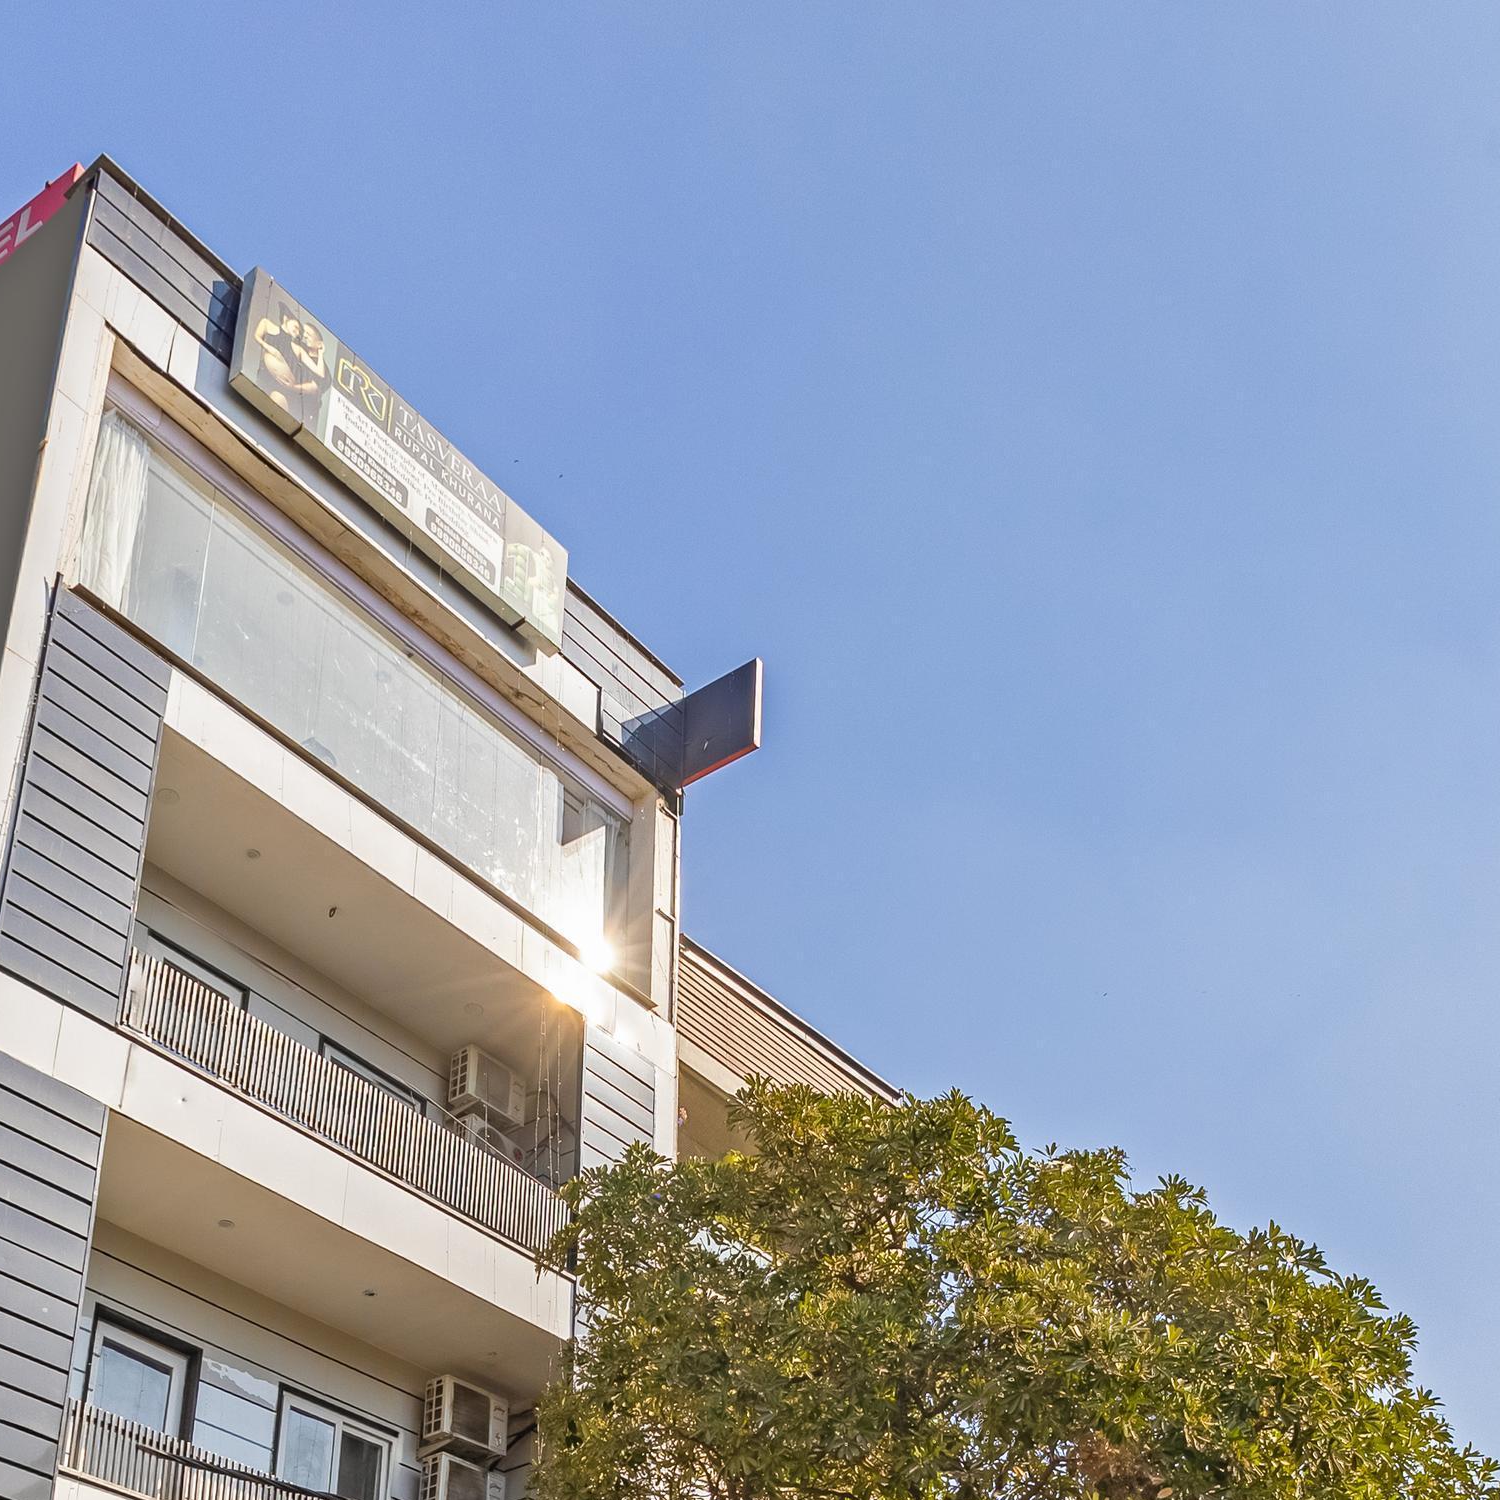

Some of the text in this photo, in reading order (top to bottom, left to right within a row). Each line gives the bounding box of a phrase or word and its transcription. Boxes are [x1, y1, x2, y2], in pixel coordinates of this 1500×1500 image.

[394, 427, 500, 529] RUPAL KHURANA
[399, 406, 502, 495] TASVERAA
